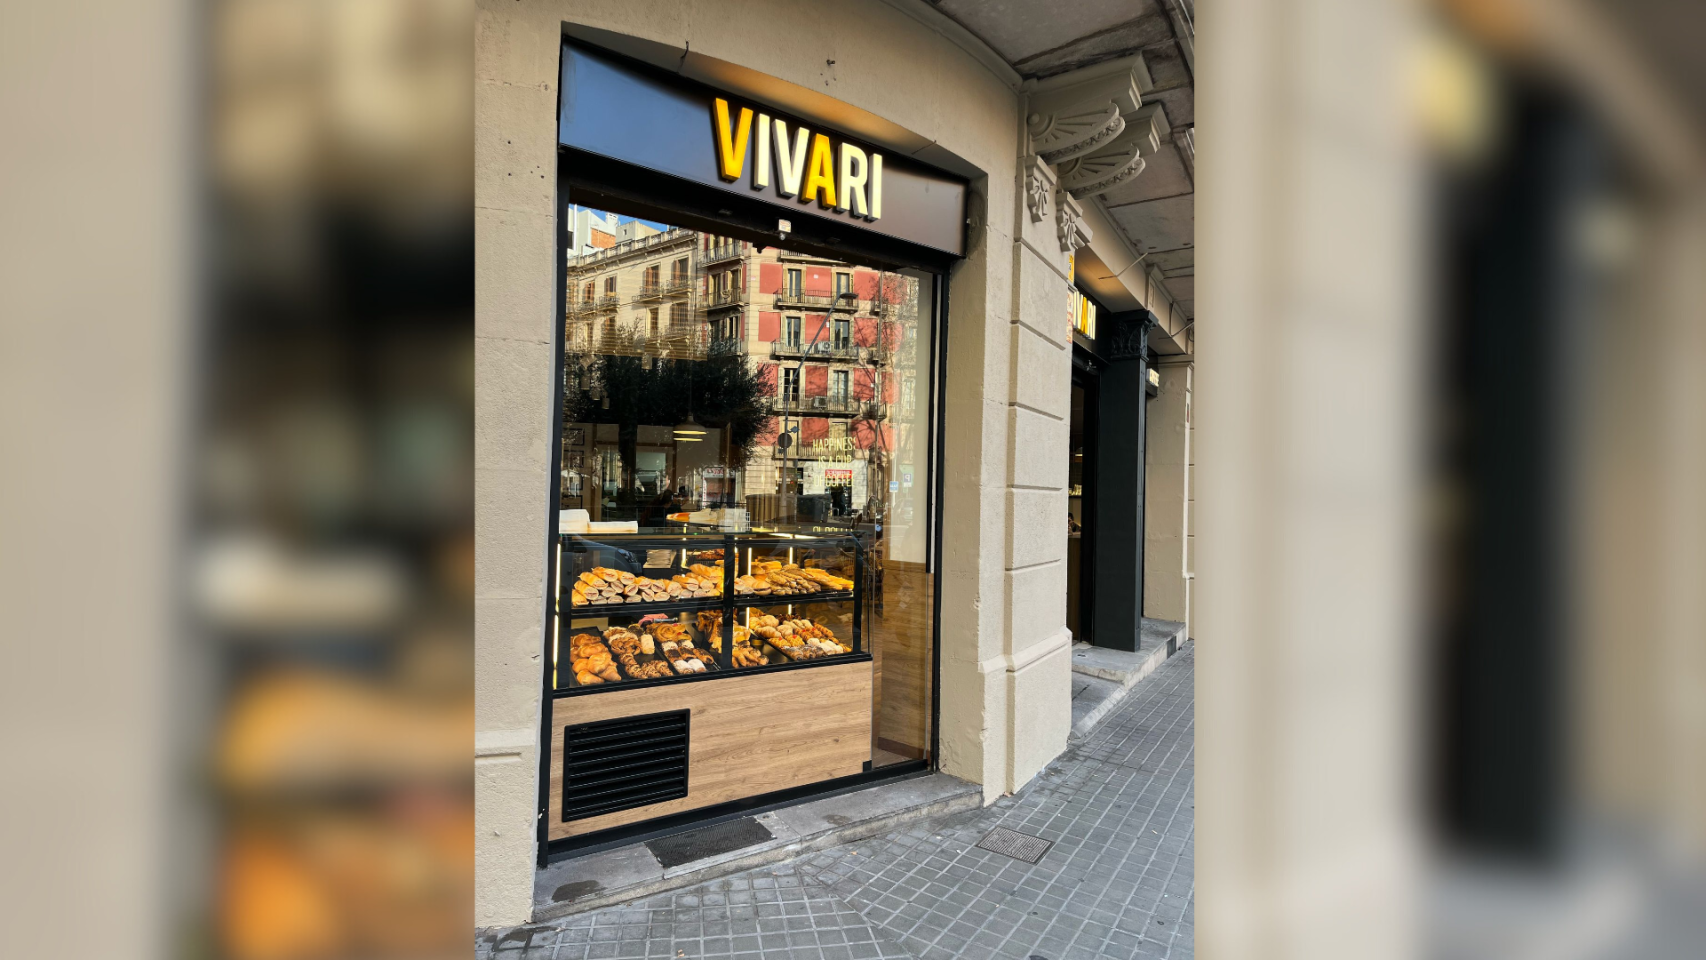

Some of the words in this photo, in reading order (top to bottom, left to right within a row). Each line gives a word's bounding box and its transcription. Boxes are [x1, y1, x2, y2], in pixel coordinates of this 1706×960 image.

[713, 98, 882, 220] VIVARI
[1073, 291, 1097, 340] IVARI
[818, 455, 826, 469] IS
[828, 455, 833, 469] A
[835, 454, 852, 469] CUP
